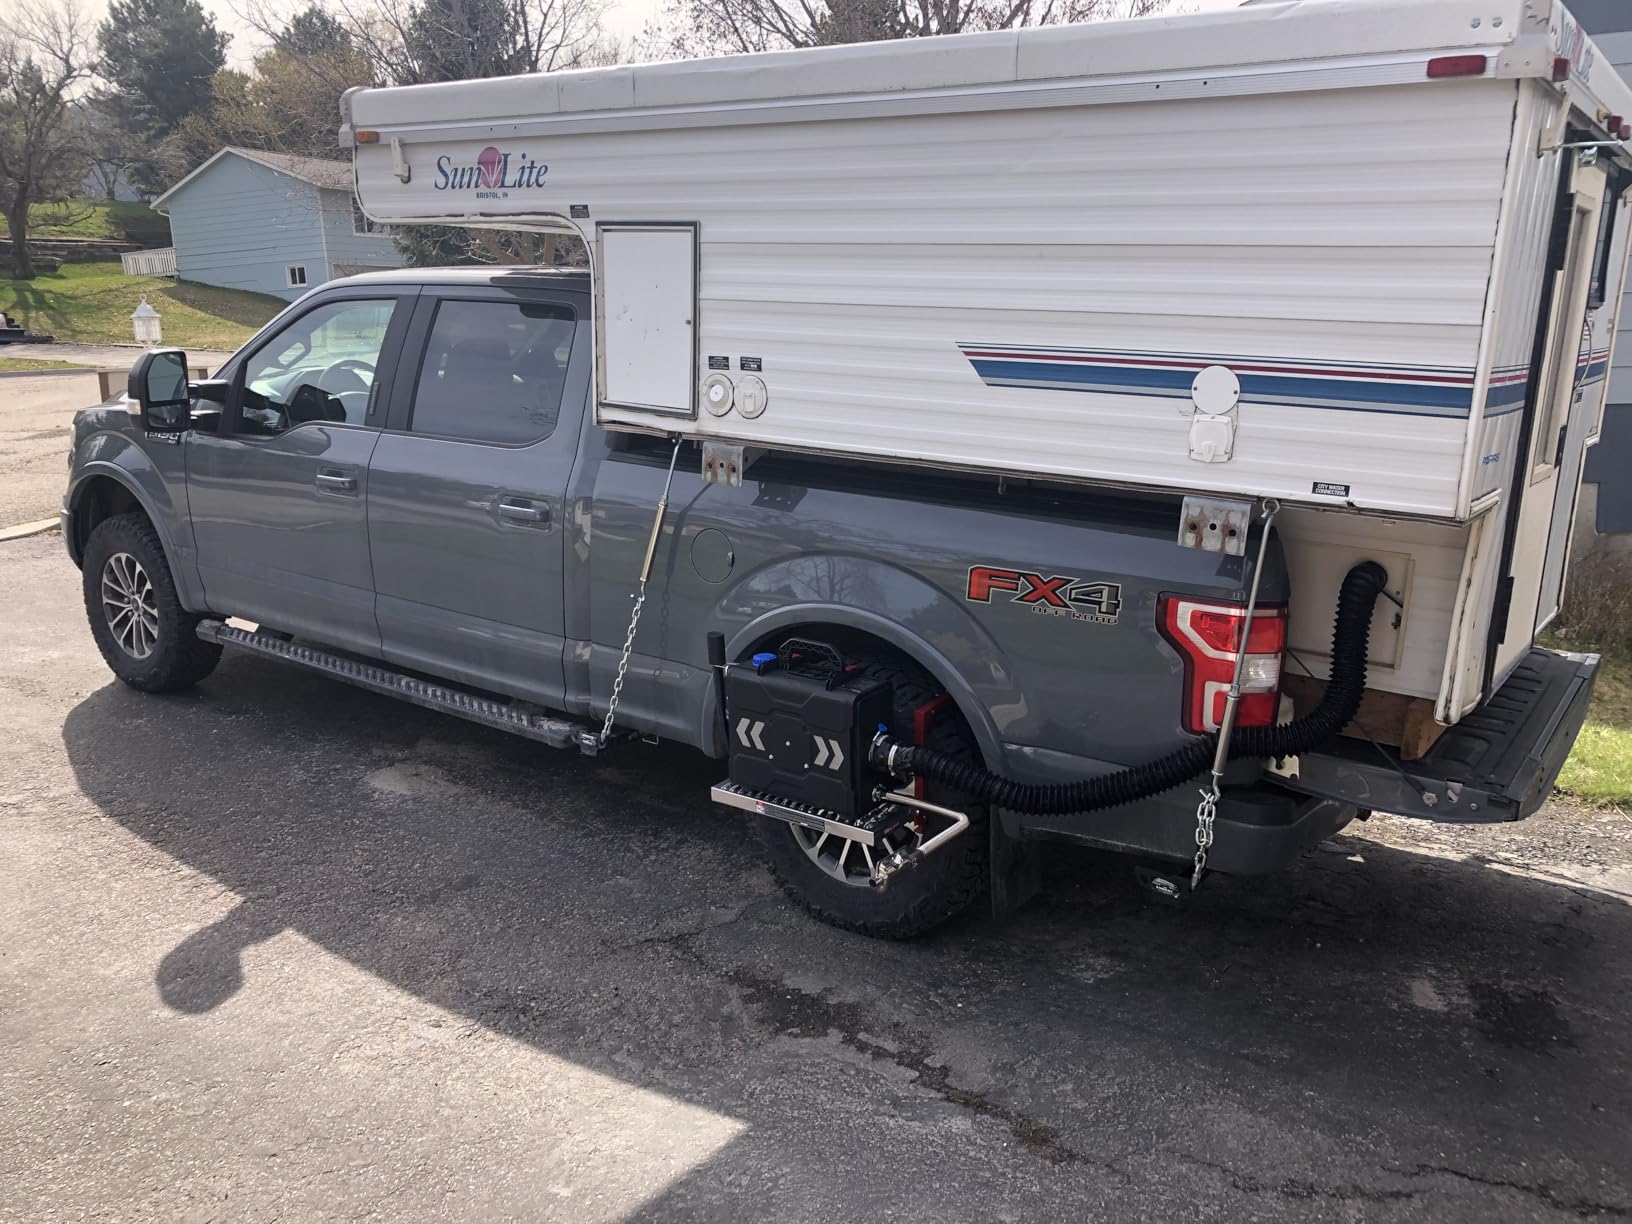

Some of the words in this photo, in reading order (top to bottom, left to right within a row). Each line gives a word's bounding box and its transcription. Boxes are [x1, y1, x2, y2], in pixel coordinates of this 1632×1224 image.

[434, 155, 482, 190] Sun
[498, 152, 549, 188] Lite
[476, 191, 501, 200] BRISTOL,
[1315, 487, 1346, 496] CONNECTION
[966, 564, 1123, 617] FX4
[1031, 605, 1065, 617] OFF
[1071, 612, 1119, 625] ROAD
